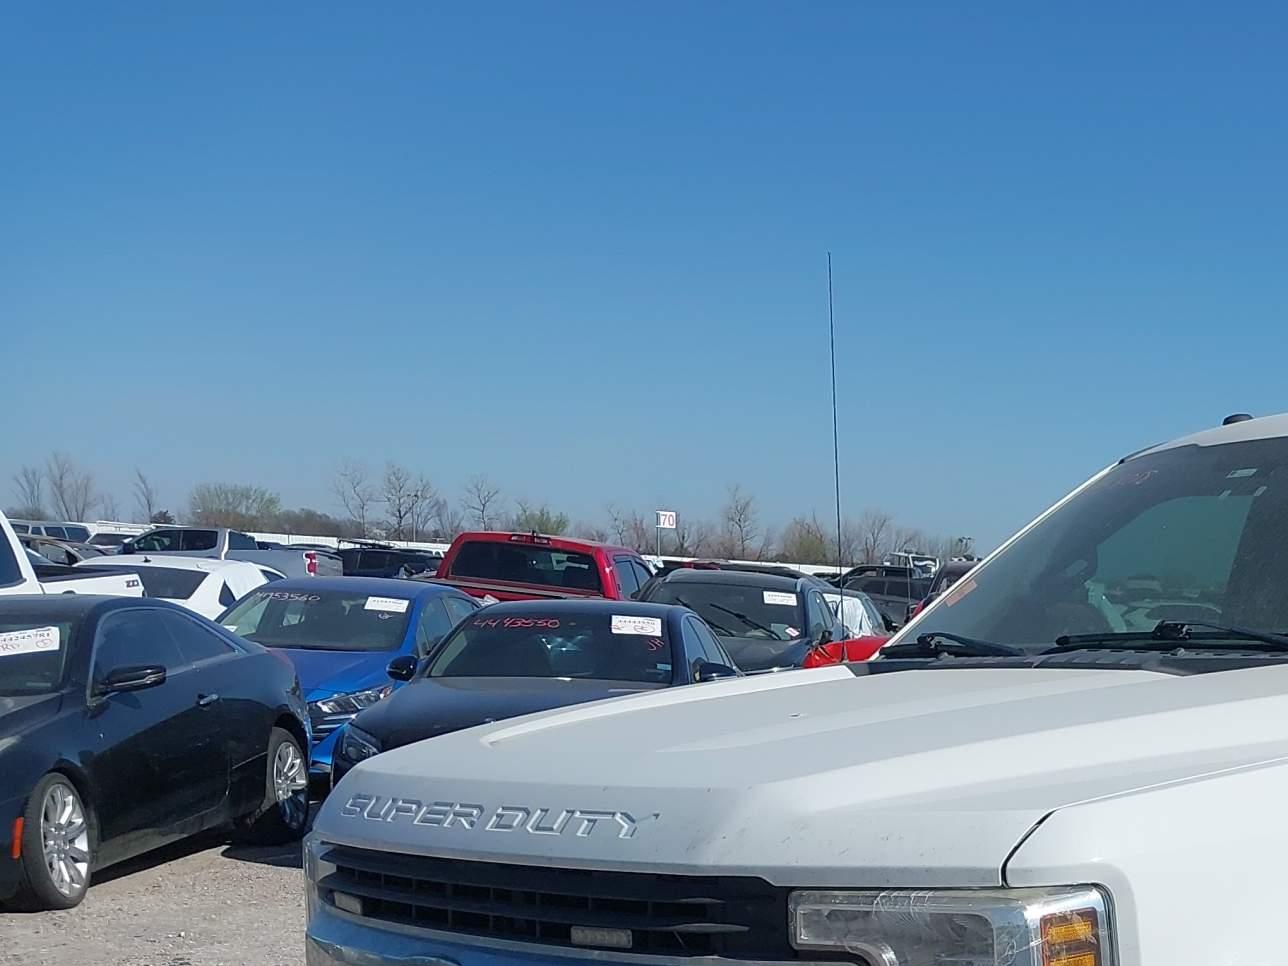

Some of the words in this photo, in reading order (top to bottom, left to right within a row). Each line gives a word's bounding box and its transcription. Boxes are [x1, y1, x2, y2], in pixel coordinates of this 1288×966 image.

[661, 513, 675, 527] 70
[340, 793, 485, 831] SUPER
[485, 805, 640, 839] DUTY
